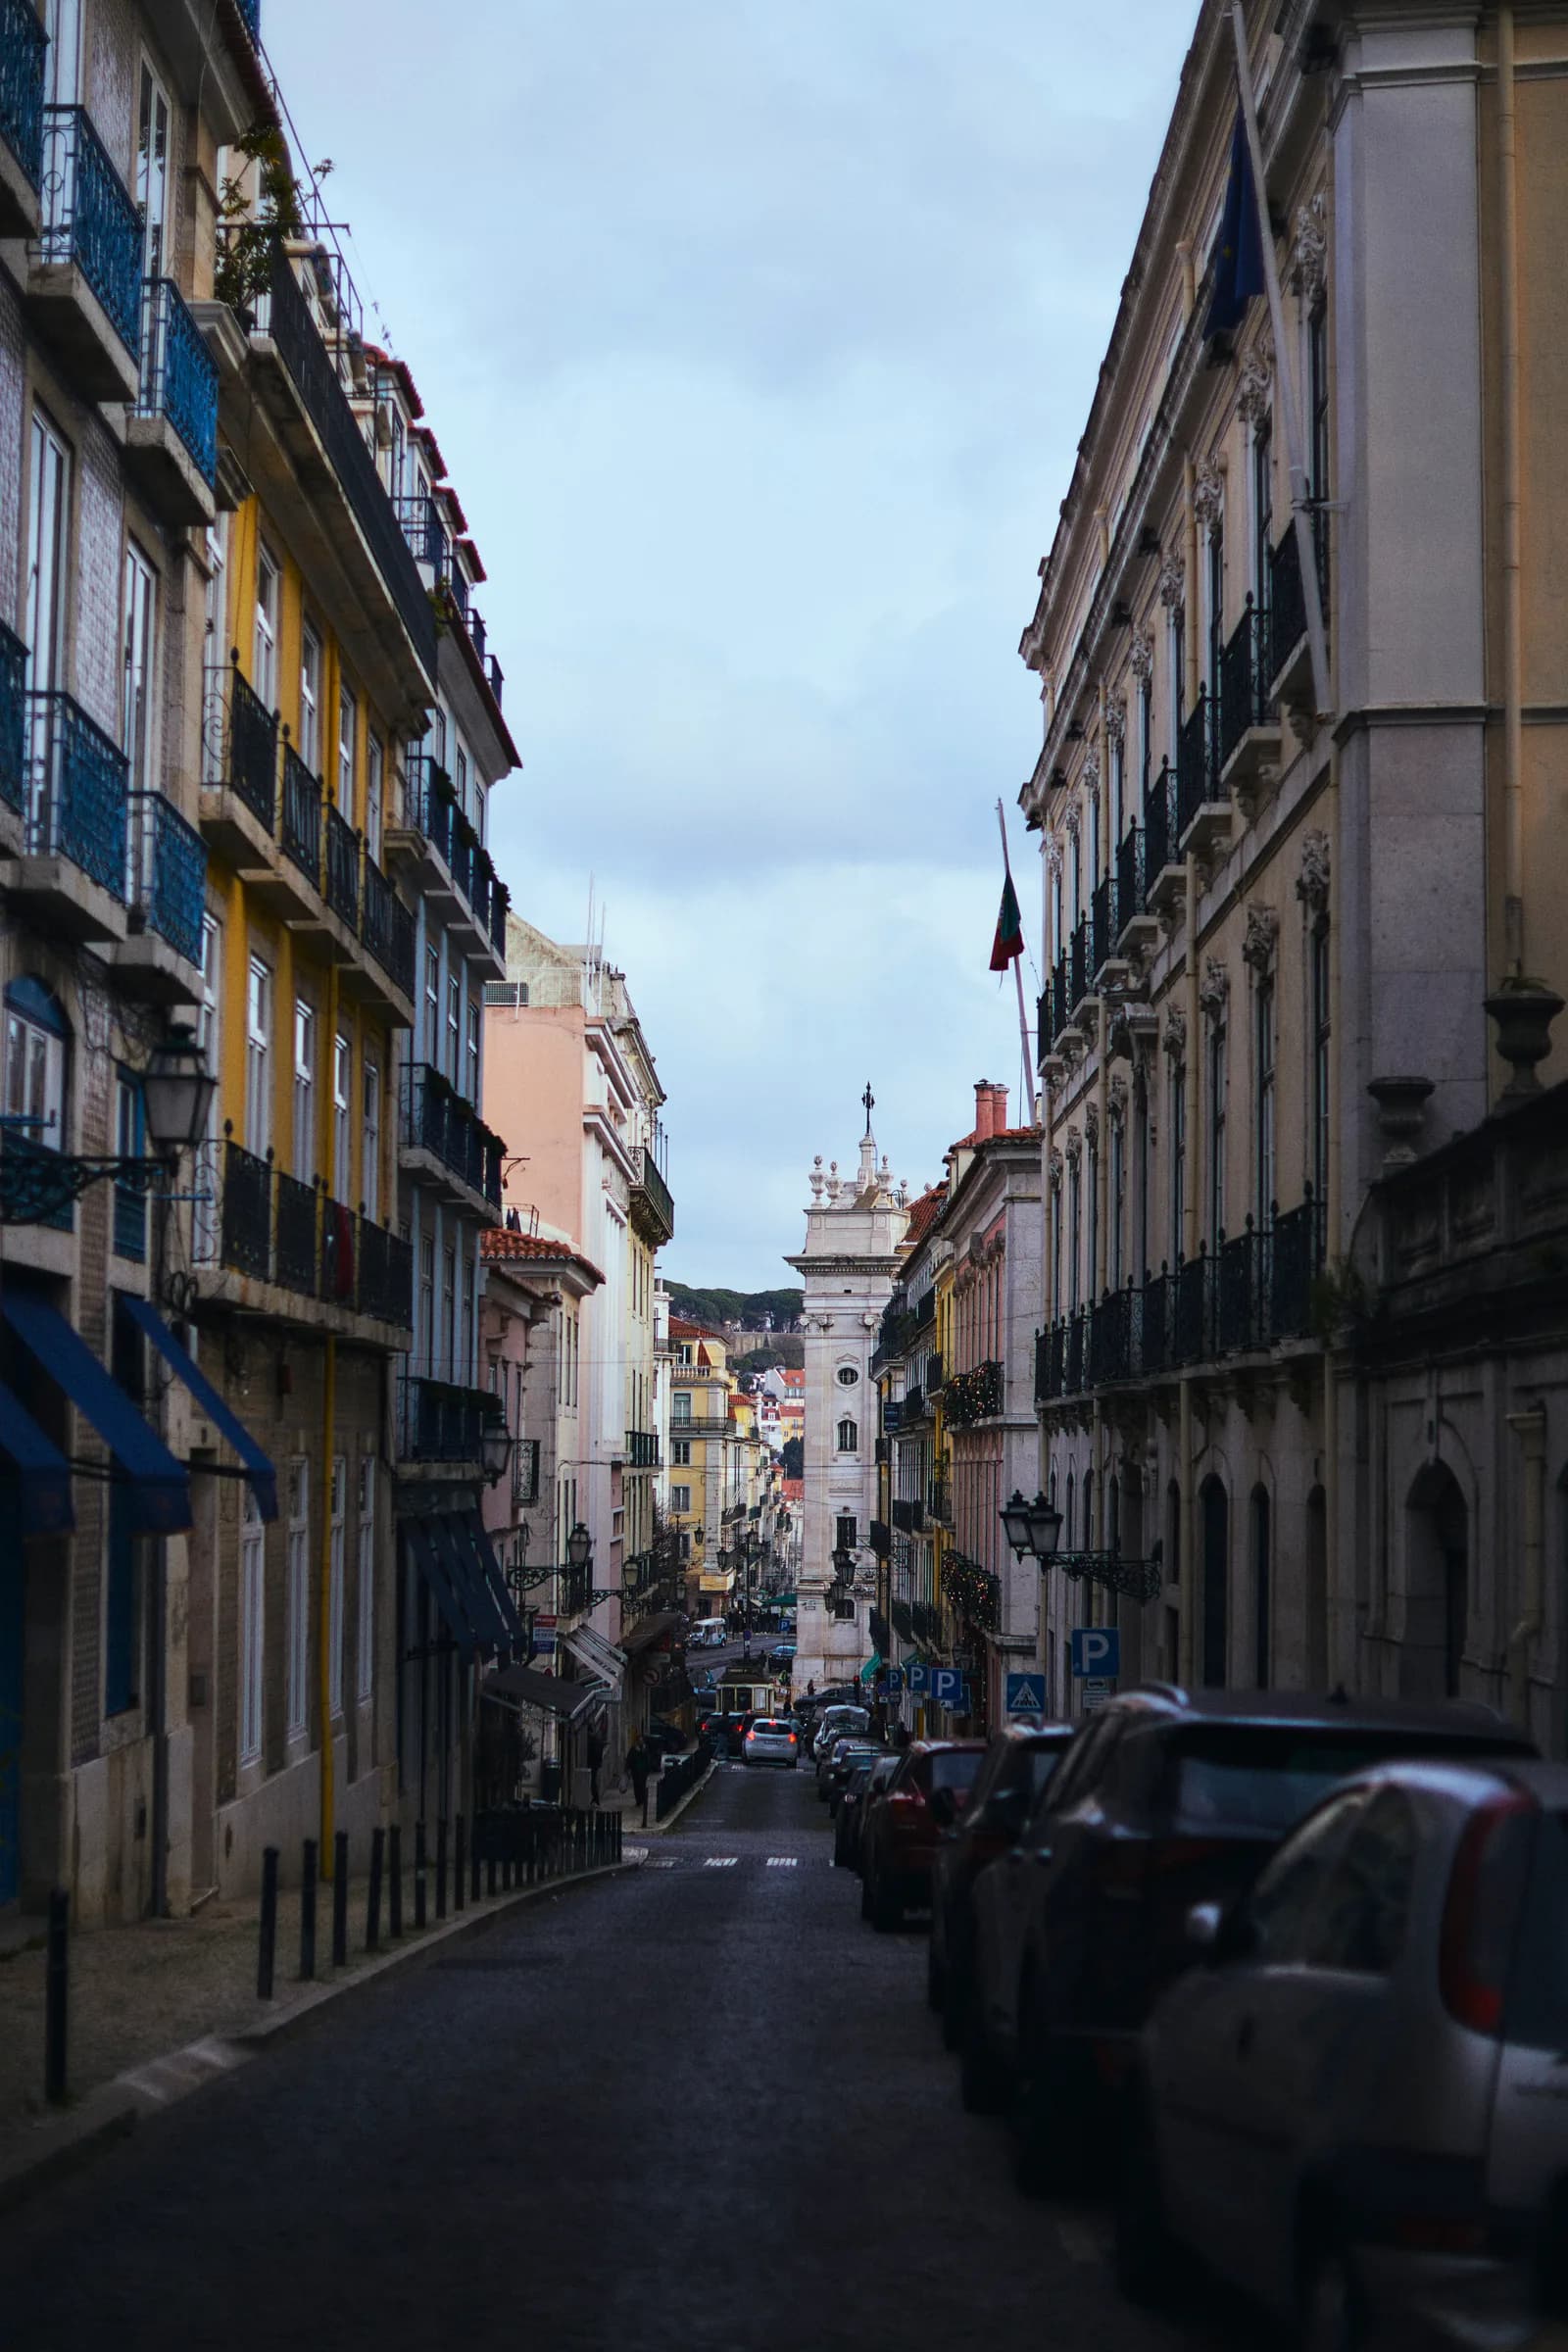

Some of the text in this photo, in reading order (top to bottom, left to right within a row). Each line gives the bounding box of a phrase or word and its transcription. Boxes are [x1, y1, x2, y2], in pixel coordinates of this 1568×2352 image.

[1081, 1633, 1109, 1673] P
[889, 1672, 899, 1689] P
[909, 1666, 924, 1689] P
[937, 1671, 956, 1697] P
